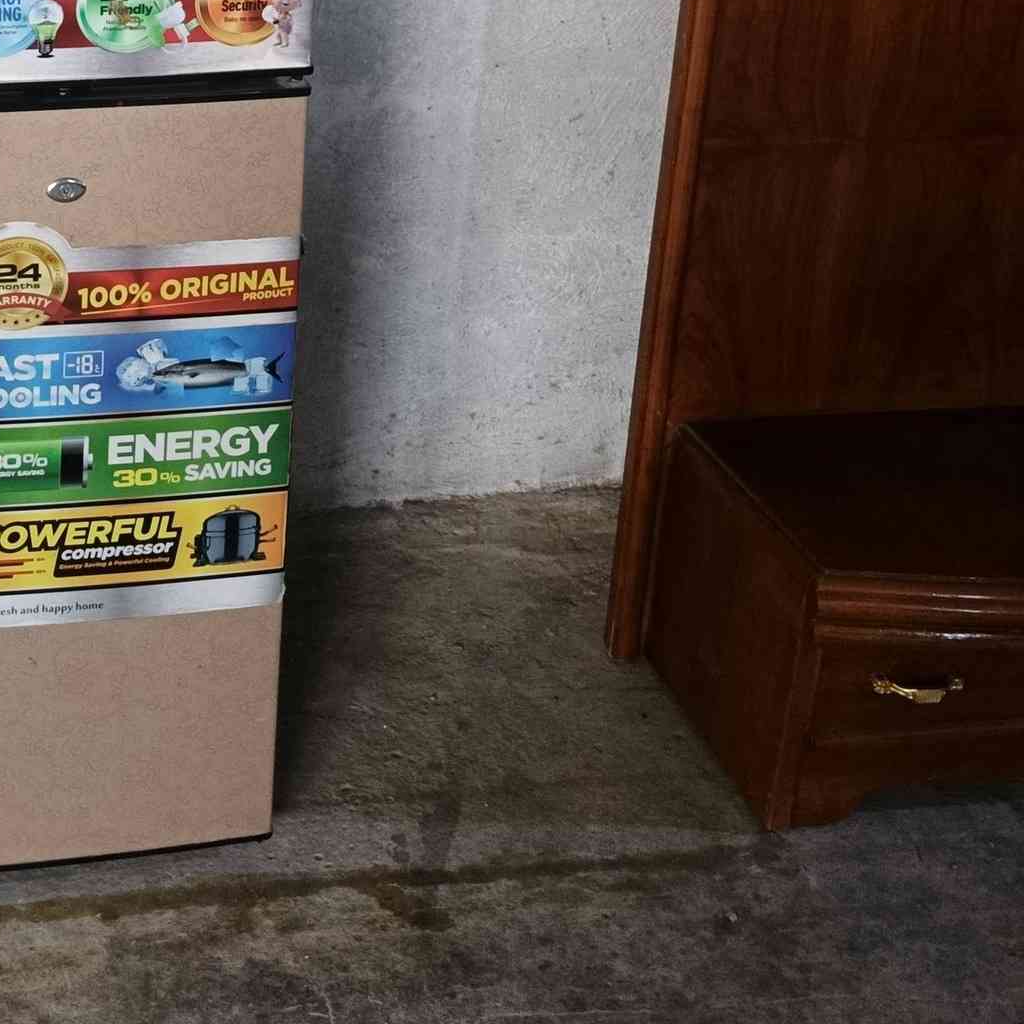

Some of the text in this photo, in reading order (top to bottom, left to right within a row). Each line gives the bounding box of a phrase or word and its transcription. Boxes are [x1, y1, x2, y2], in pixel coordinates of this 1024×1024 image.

[78, 266, 295, 309] 100% ORIGINAL
[242, 287, 294, 302] PRODUCT
[108, 423, 279, 465] ENERGY
[184, 458, 272, 482] SAVING
[61, 541, 174, 561] compressor
[20, 605, 39, 615] and
[42, 602, 73, 616] happy
[76, 600, 104, 611] home
